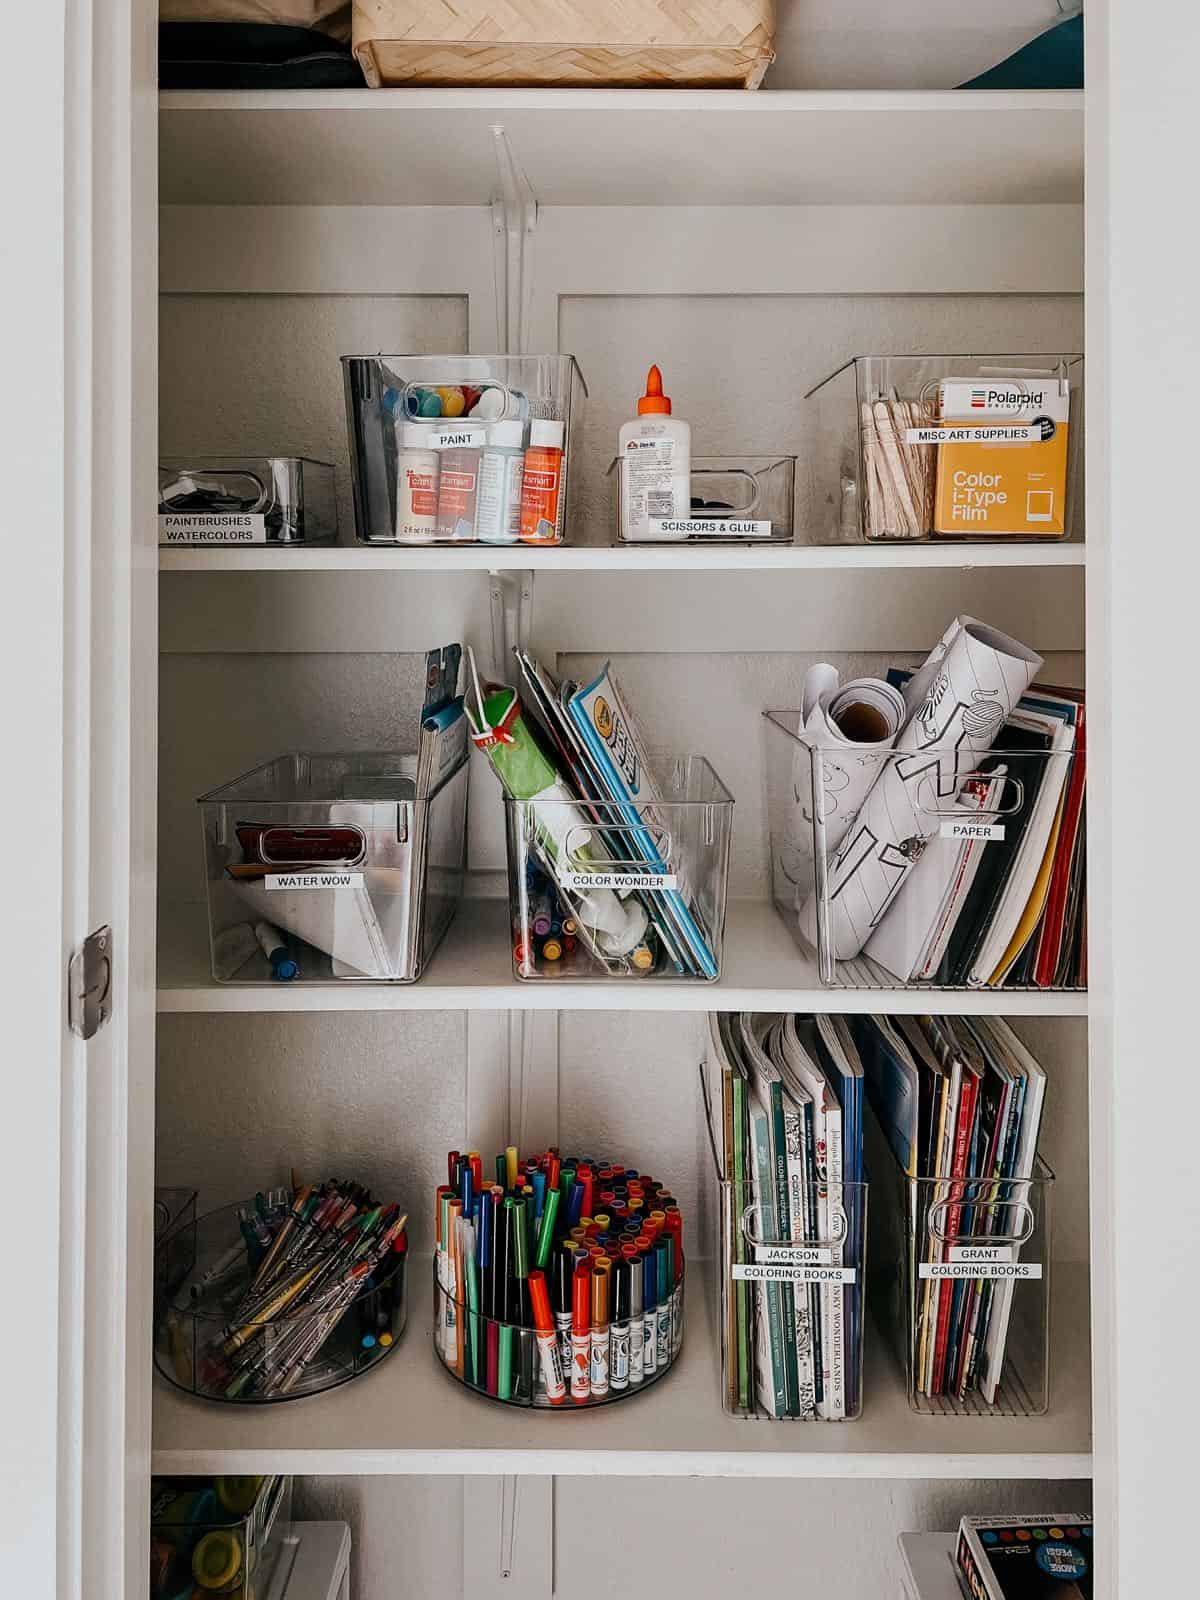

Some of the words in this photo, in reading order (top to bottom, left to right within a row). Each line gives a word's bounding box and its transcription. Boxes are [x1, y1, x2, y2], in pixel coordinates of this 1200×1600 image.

[988, 390, 1043, 404] Polaroid
[439, 434, 473, 445] PAINT
[918, 431, 945, 441] MISC
[949, 430, 971, 440] ART
[974, 429, 1029, 439] SUPPLIES
[953, 470, 1002, 487] Color
[952, 487, 1008, 507] i-Type
[952, 504, 988, 521] Film
[165, 517, 252, 526] PAINTBRUSHES
[661, 522, 716, 532] SCISSORS
[719, 523, 726, 532] &
[729, 522, 759, 533] GLUE
[166, 531, 253, 540] WATERCOLORS
[953, 826, 991, 836] PAPER
[278, 877, 318, 886] WATER
[320, 876, 351, 885] WOW
[573, 876, 611, 885] COLOR
[614, 876, 664, 886] WONDER
[777, 1155, 785, 1192] COLORING
[768, 1250, 819, 1260] JACKSON
[961, 1249, 999, 1259] GRANT
[744, 1268, 801, 1278] COLORING
[804, 1270, 843, 1280] BOOKS
[931, 1266, 988, 1275] COLORING
[991, 1266, 1030, 1276] BOOKS
[833, 1285, 841, 1310] INKY
[833, 1312, 842, 1392] WONDERLANDS
